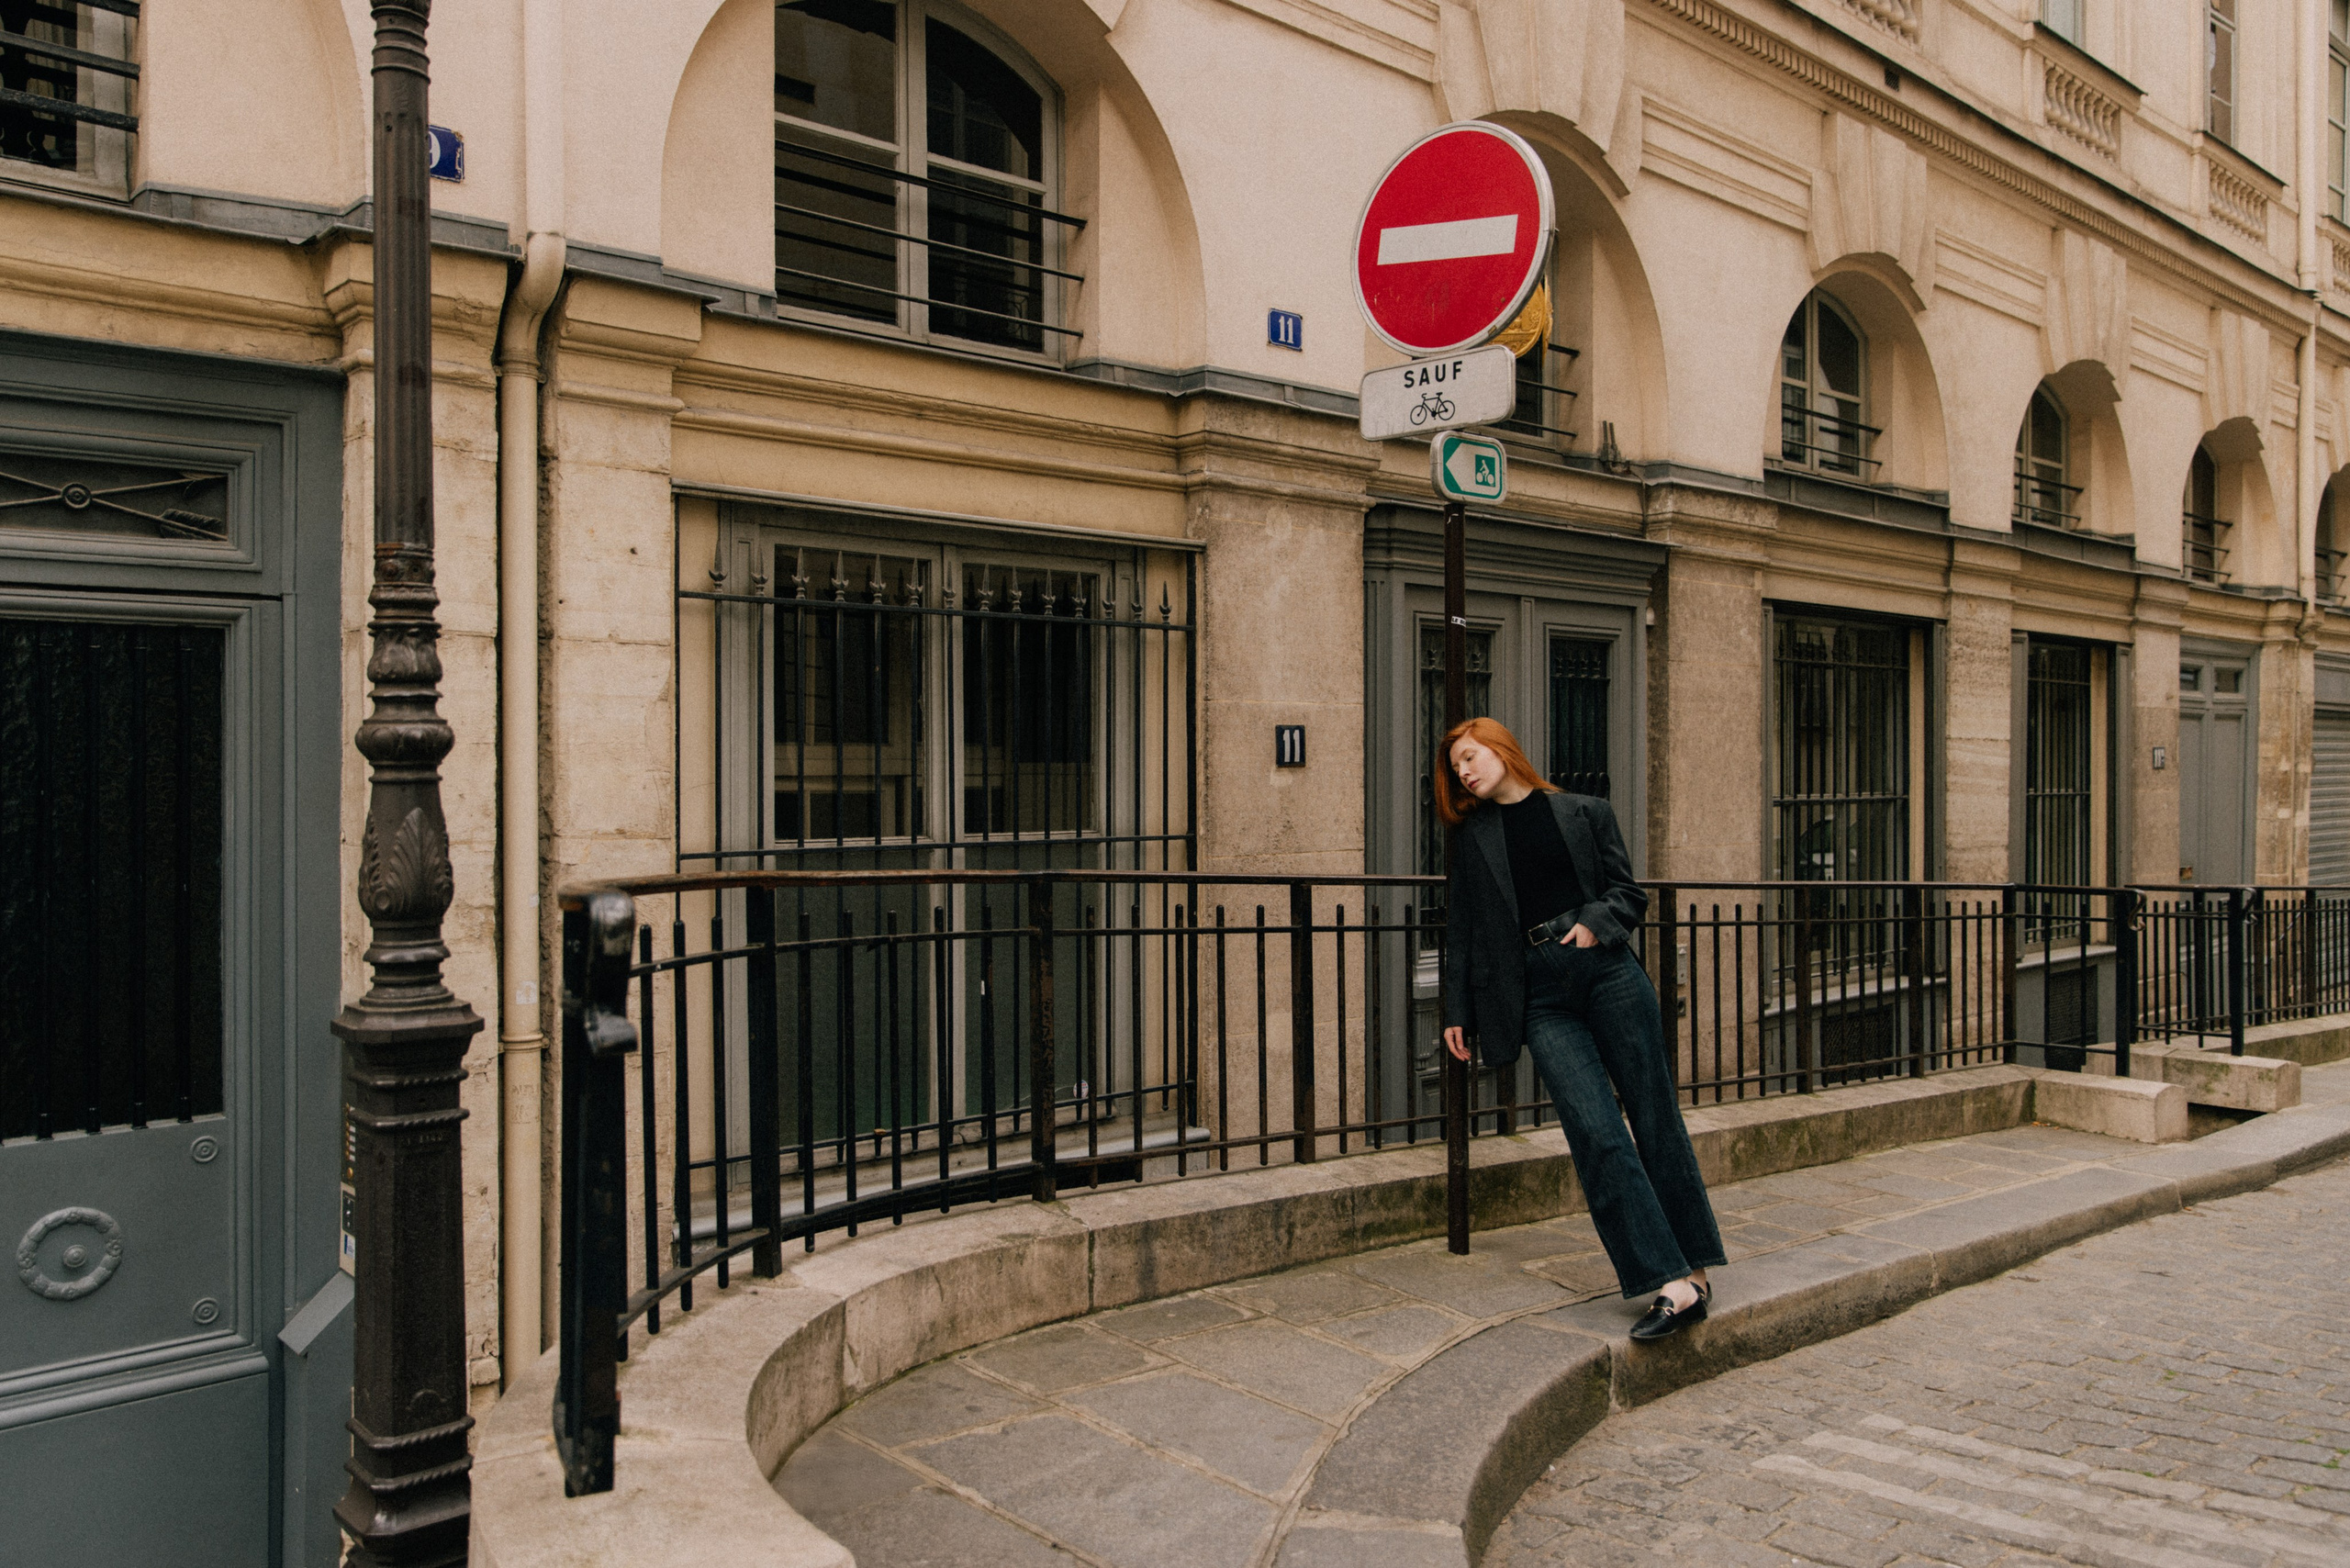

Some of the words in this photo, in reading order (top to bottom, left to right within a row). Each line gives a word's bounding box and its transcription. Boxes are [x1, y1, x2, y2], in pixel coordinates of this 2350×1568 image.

[1278, 315, 1294, 343] 11
[1404, 360, 1462, 388] SAUF
[1282, 729, 1301, 763] 11
